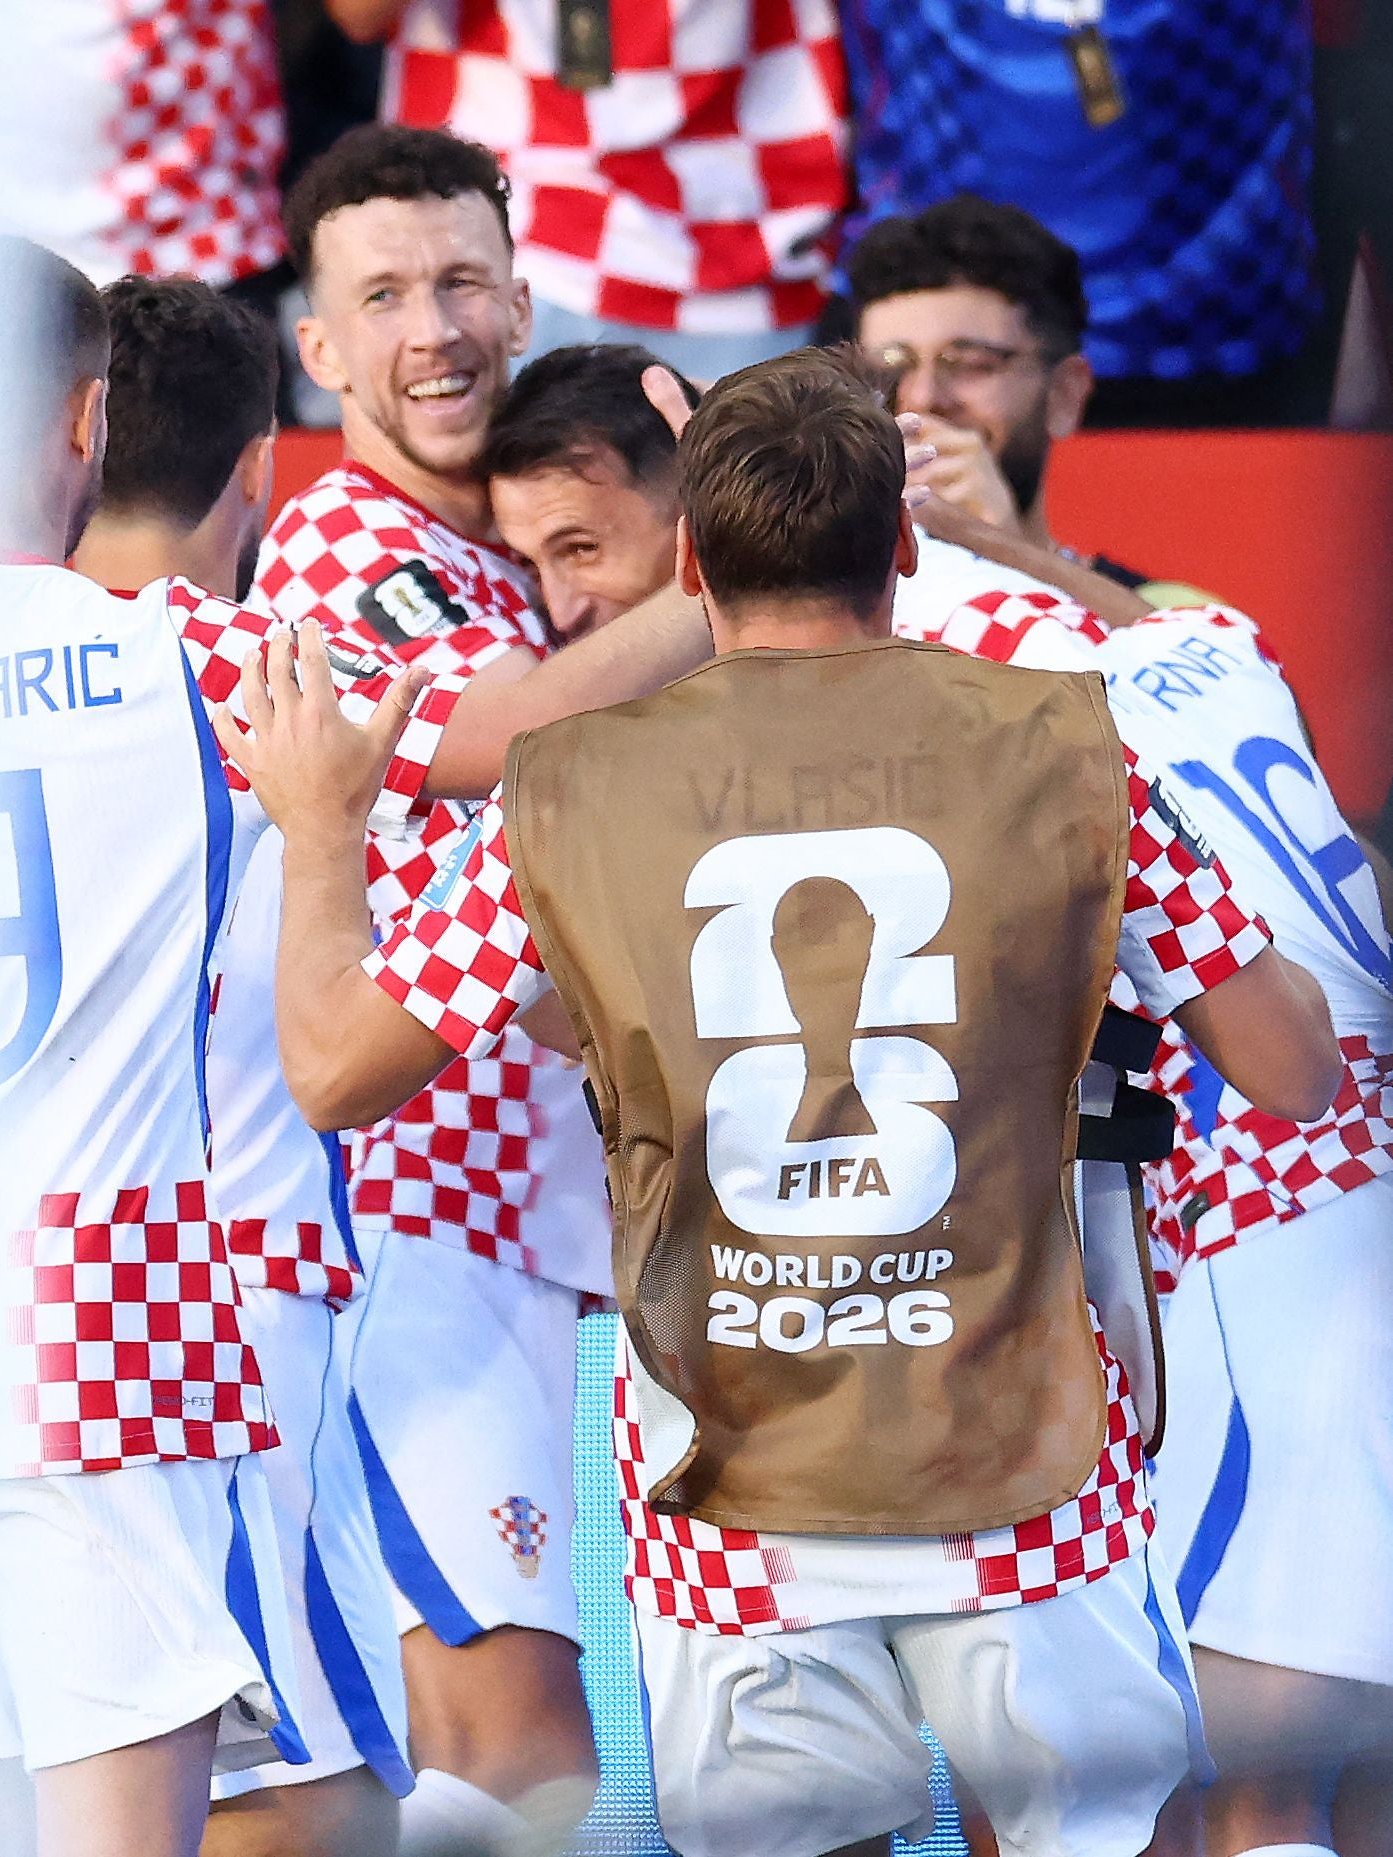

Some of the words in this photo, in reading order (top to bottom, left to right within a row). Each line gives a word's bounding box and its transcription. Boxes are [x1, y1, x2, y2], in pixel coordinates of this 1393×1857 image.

[777, 1157, 891, 1201] FIFA
[710, 1244, 863, 1289] WORLD
[869, 1249, 954, 1284] CUP
[707, 1289, 954, 1353] 2026
